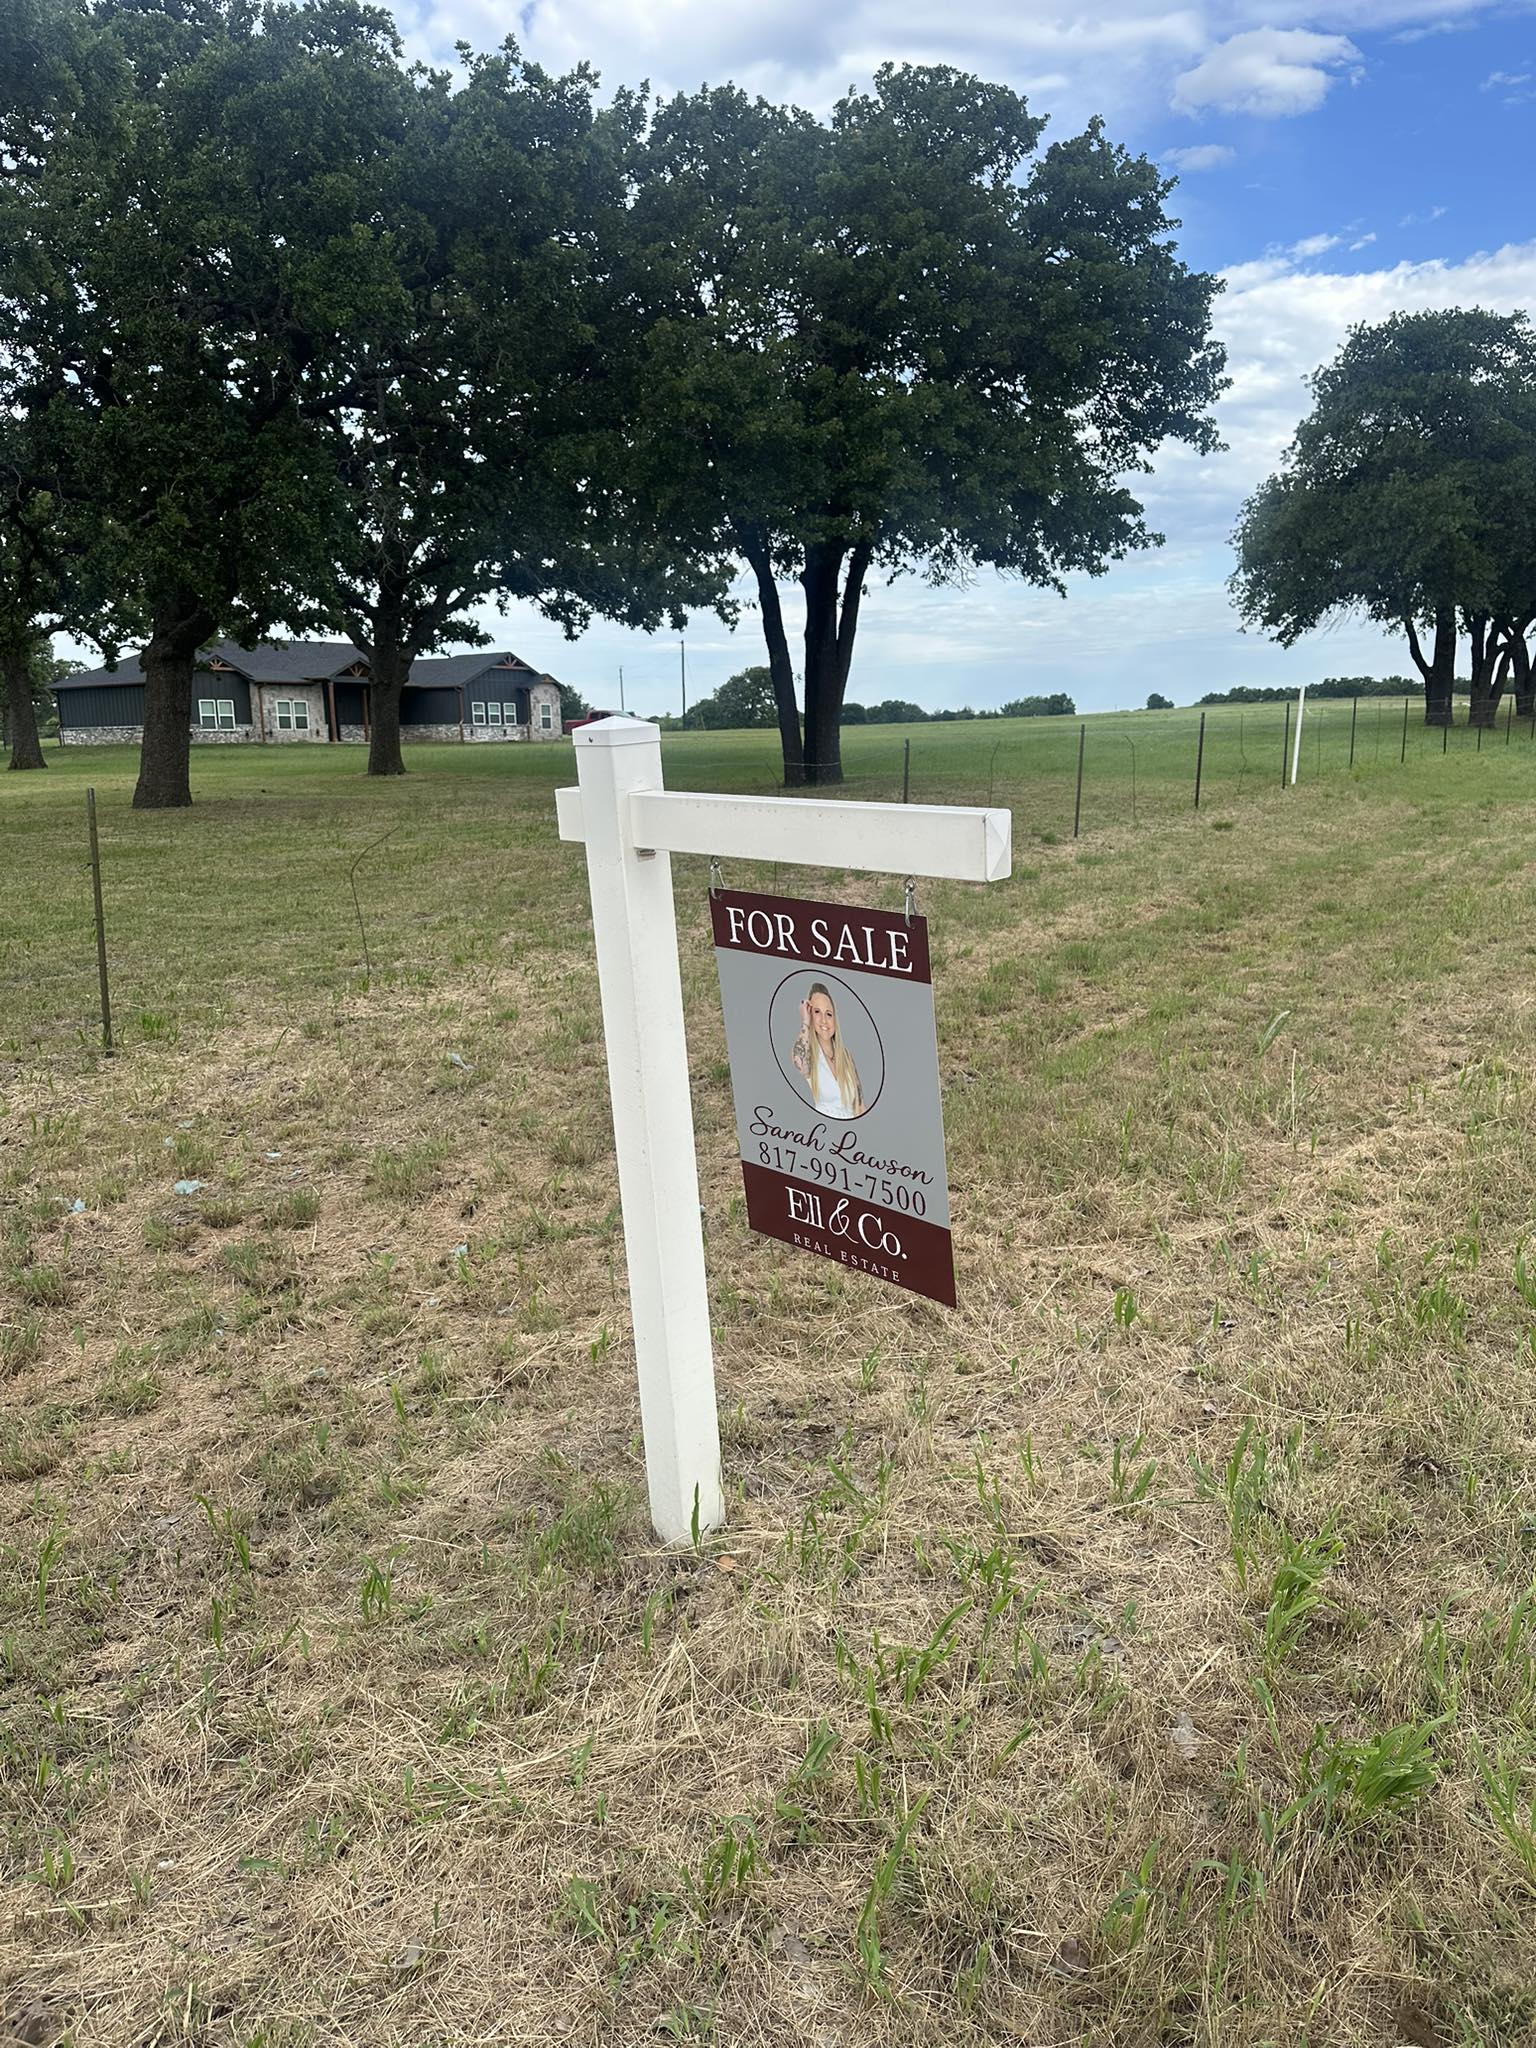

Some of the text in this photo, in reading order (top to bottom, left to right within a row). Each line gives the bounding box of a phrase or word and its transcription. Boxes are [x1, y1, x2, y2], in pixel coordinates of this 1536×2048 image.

[726, 906, 913, 973] FOR SALE
[749, 1105, 934, 1185] Sarah Lawson
[758, 1141, 926, 1216] 817-991-7500
[793, 1233, 901, 1282] REAL ESTATE
